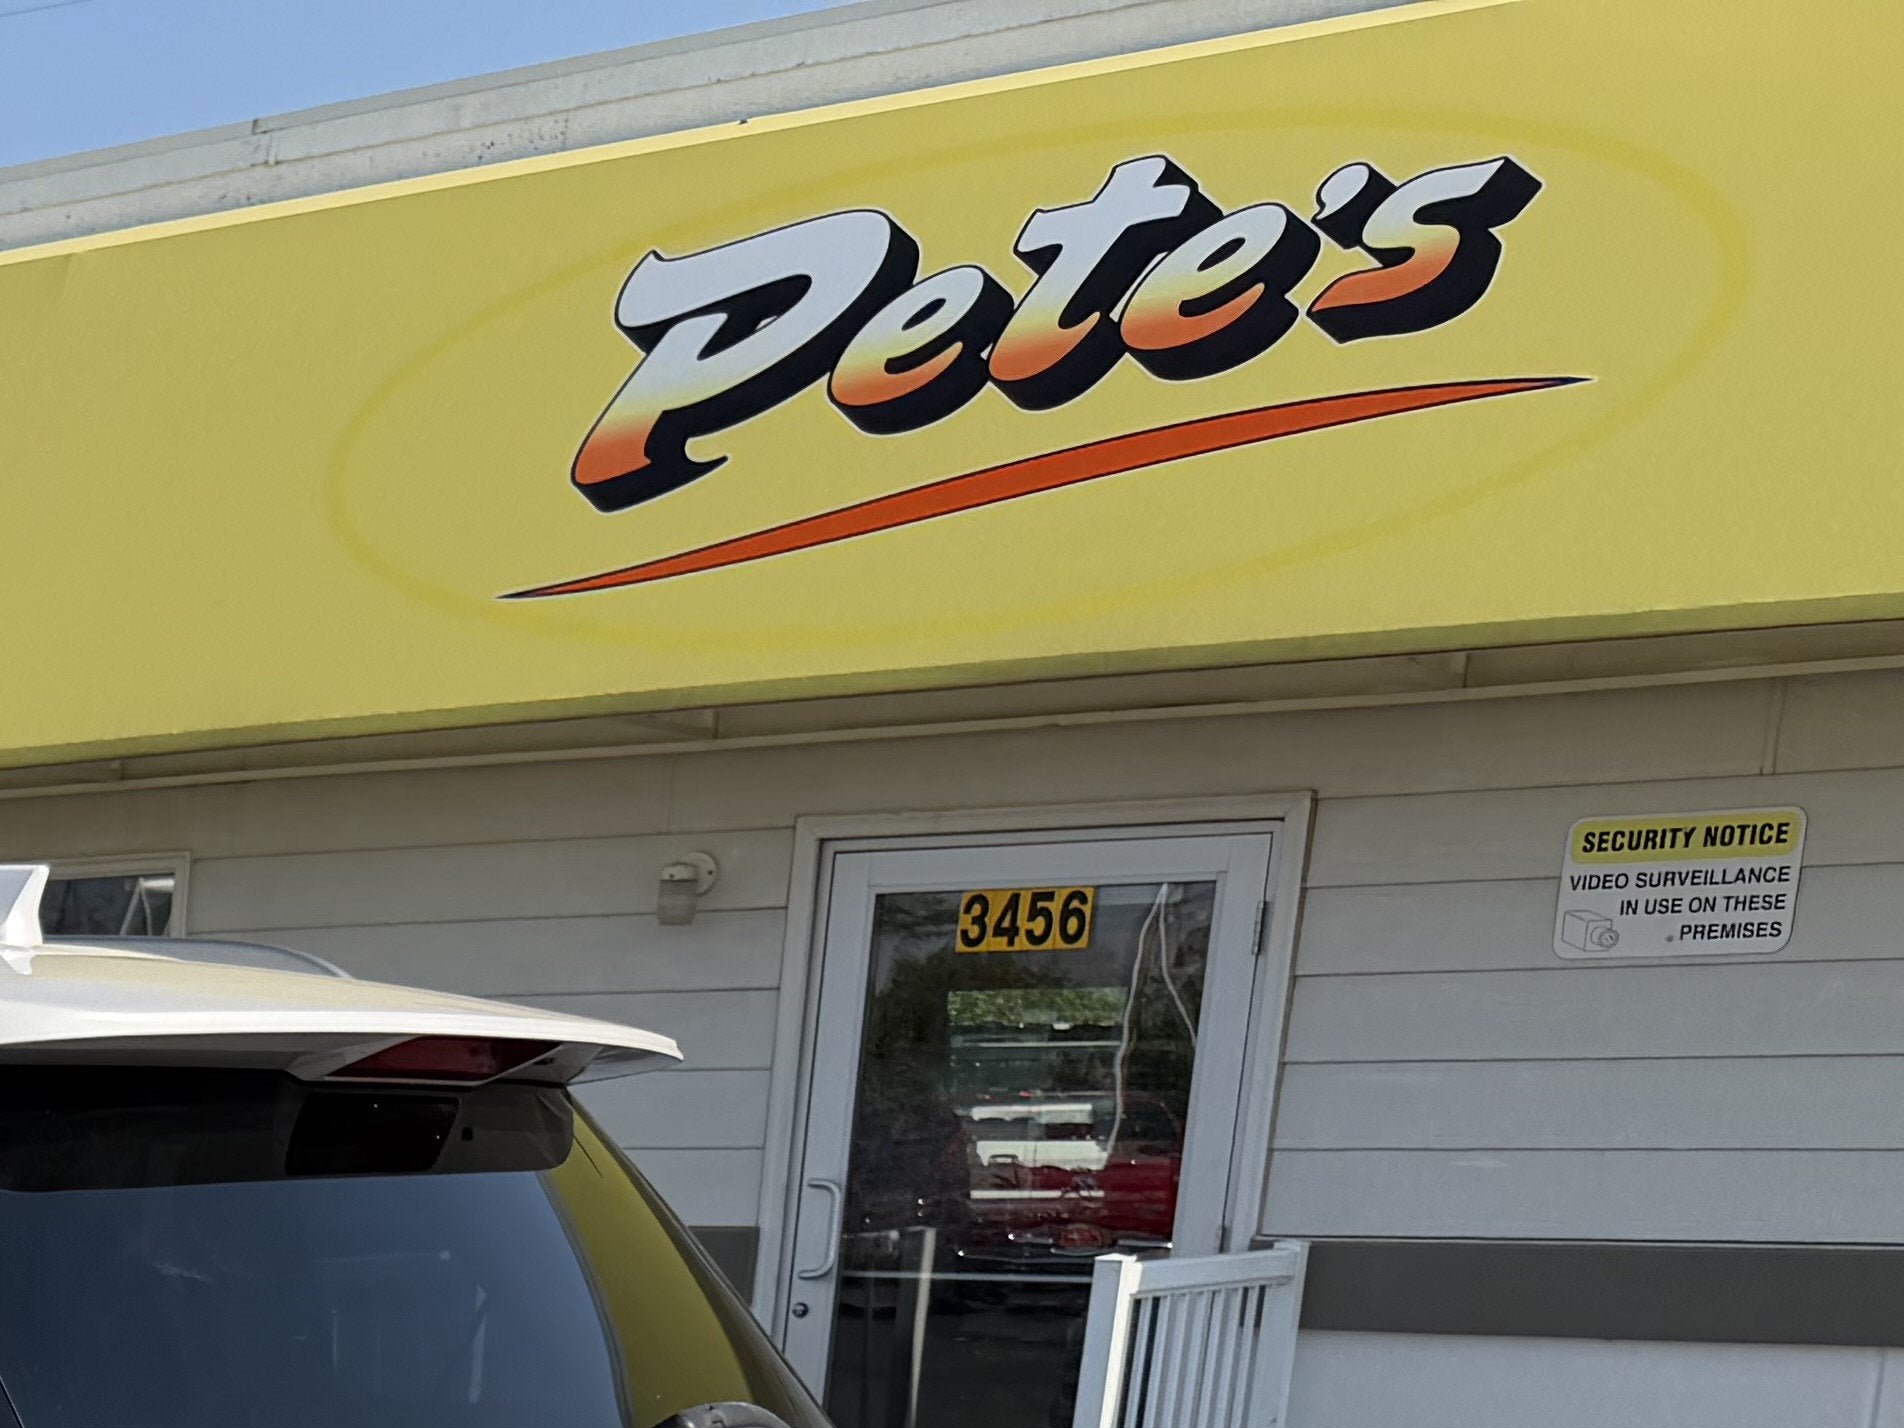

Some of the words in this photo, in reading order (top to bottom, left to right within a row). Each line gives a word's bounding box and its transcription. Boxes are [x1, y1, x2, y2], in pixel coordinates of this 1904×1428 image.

[570, 152, 1544, 514] Pete's
[1582, 825, 1697, 853] SECURITY
[1703, 822, 1790, 848] NOTICE
[1570, 871, 1629, 891] VIDEO
[1635, 865, 1792, 889] SURVEILLANCE
[960, 889, 1089, 948] 3456
[1619, 899, 1639, 916] IN
[1644, 897, 1683, 915] USE
[1688, 896, 1717, 913] ON
[1723, 893, 1788, 912] THESE
[1679, 920, 1783, 941] PREMISES
